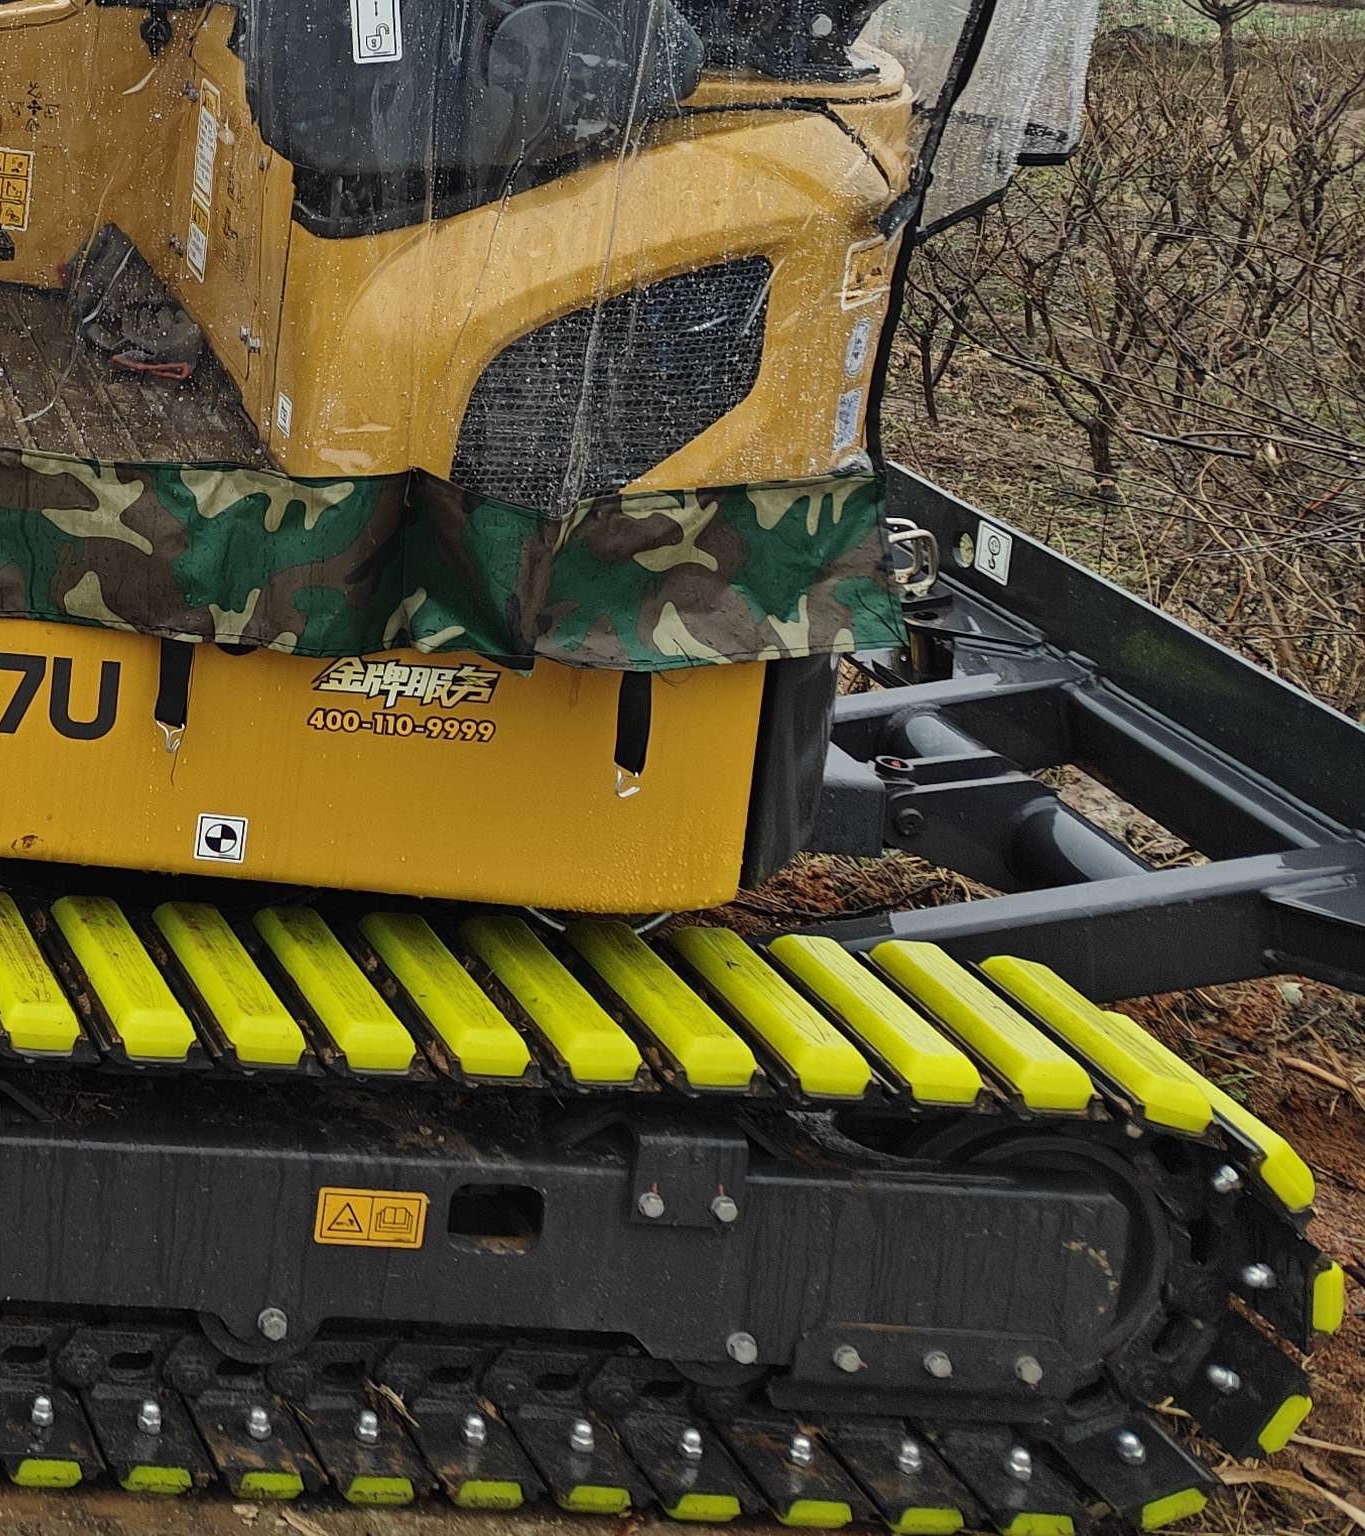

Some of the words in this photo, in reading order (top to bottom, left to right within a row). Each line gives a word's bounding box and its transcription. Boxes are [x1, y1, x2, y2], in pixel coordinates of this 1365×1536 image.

[311, 655, 501, 709] 金牌服务
[307, 706, 497, 743] 400-110-9999
